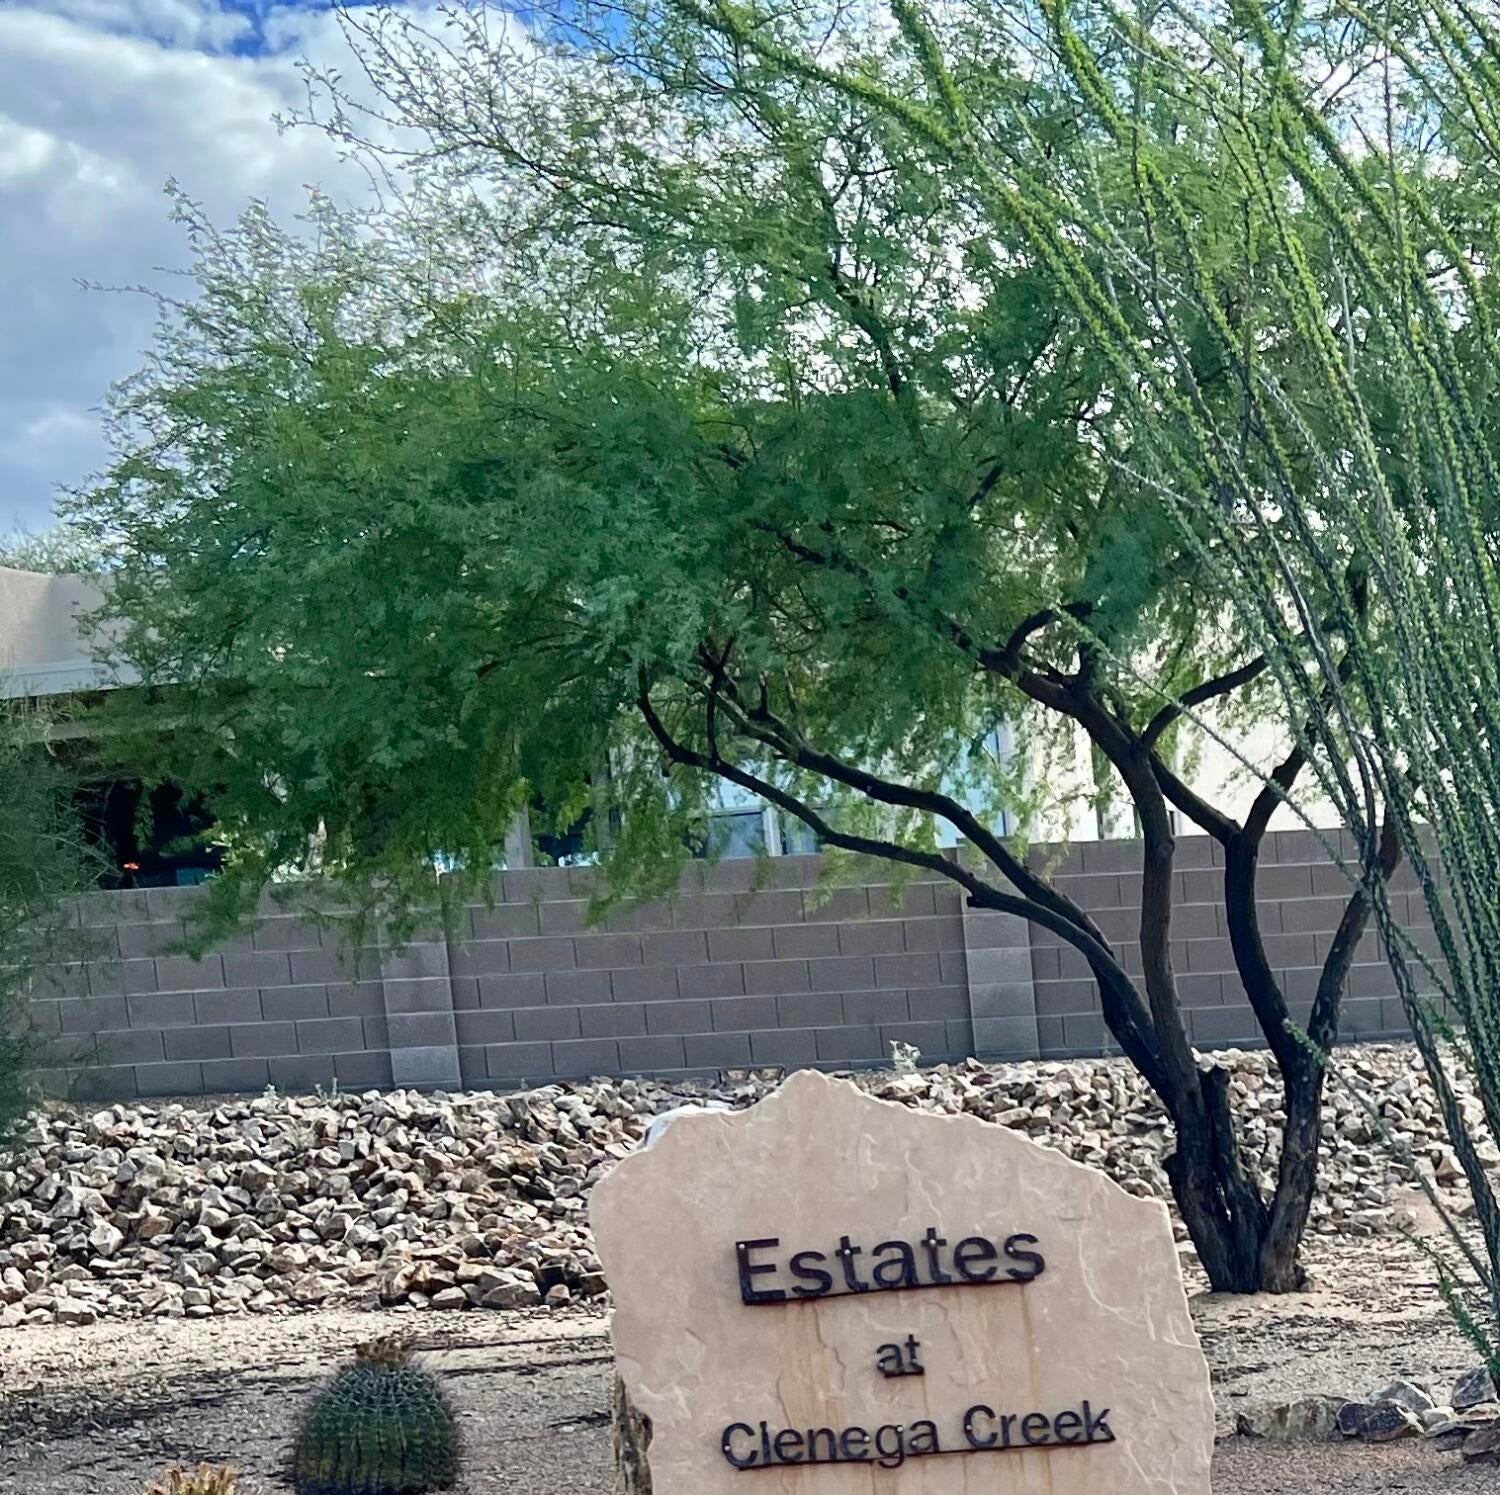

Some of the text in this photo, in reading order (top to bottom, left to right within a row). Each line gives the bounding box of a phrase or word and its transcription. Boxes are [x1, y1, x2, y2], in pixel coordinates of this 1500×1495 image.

[736, 1227, 1046, 1304] Estates
[876, 1333, 924, 1377] at
[963, 1400, 1116, 1451] Creek
